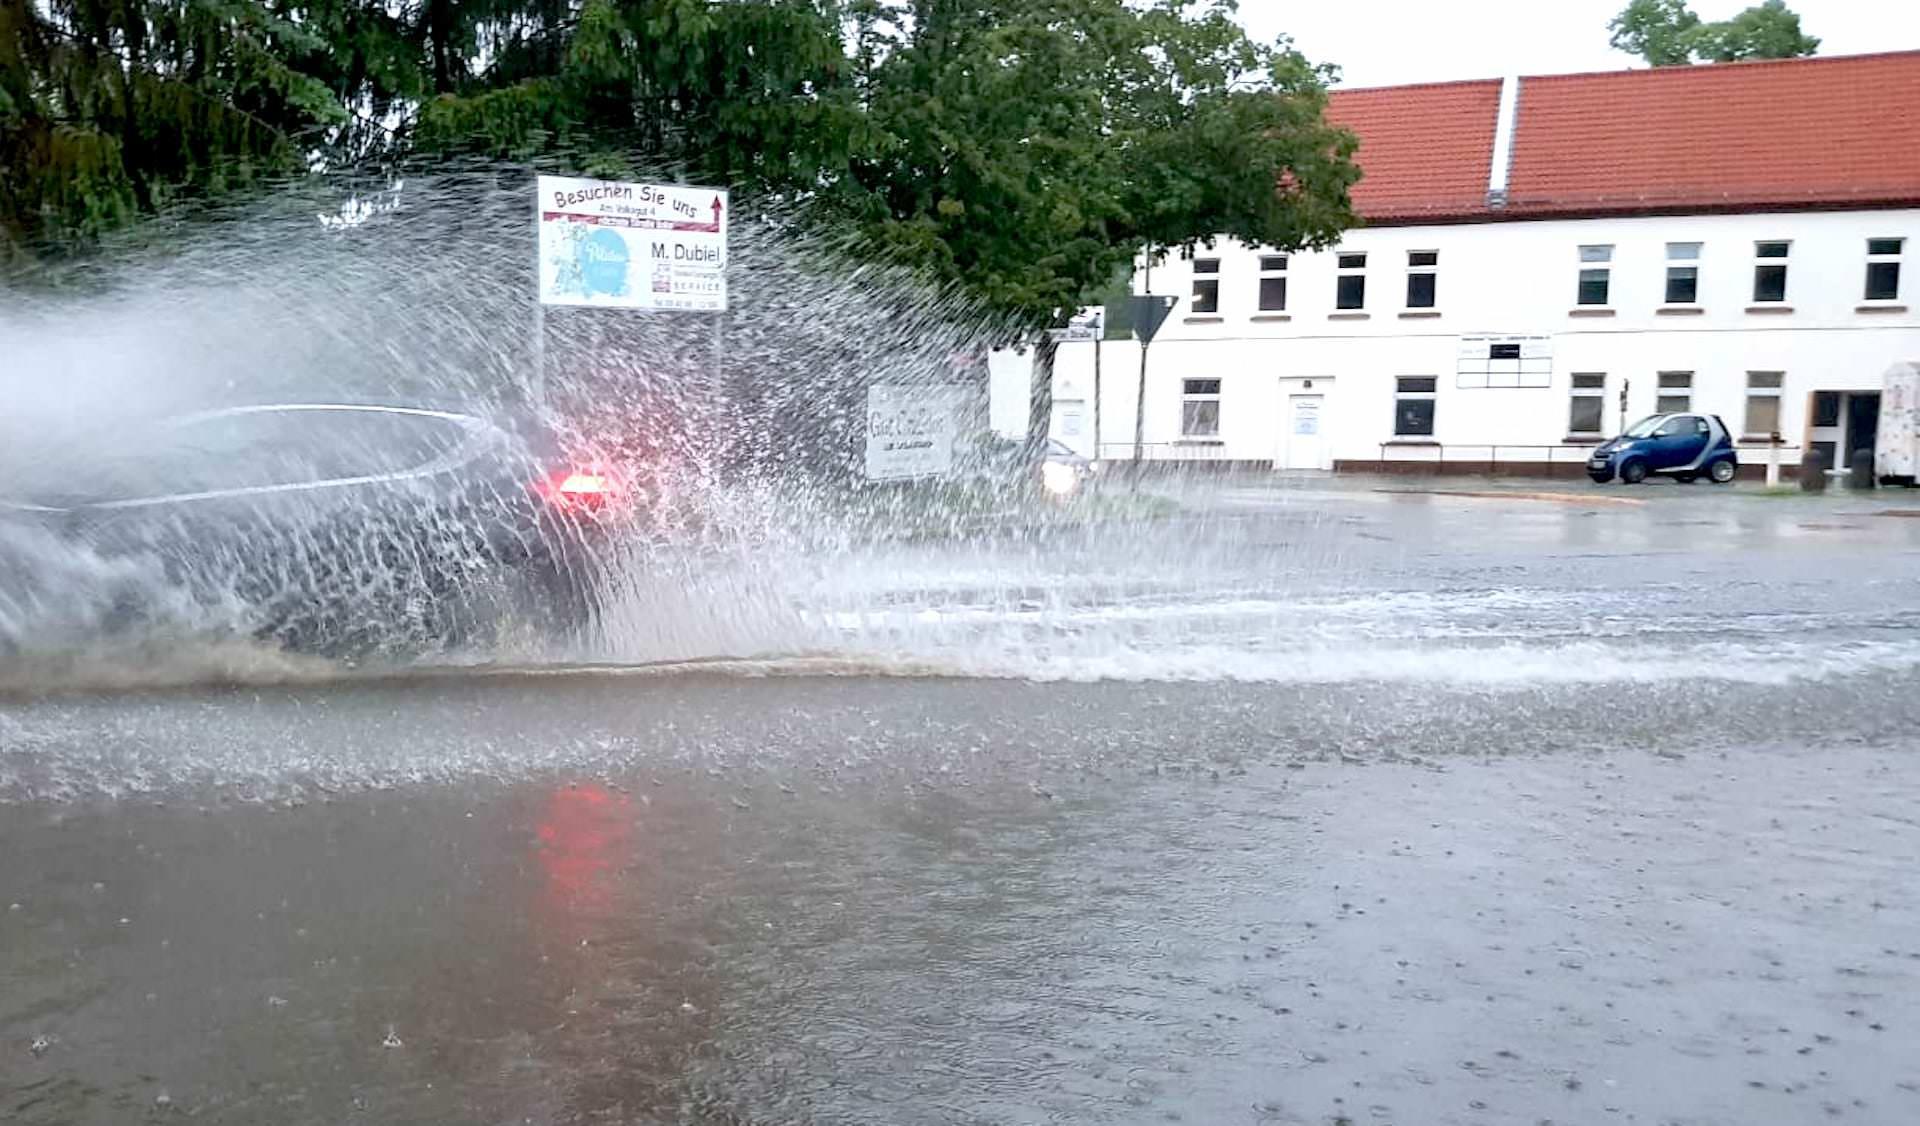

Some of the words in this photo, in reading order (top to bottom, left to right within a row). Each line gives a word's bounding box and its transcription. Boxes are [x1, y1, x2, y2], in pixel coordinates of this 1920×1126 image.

[554, 182, 632, 208] Besuchen
[640, 186, 665, 205] Sie
[672, 199, 698, 218] uns
[651, 242, 670, 259] M.
[674, 243, 720, 262] Dubiel
